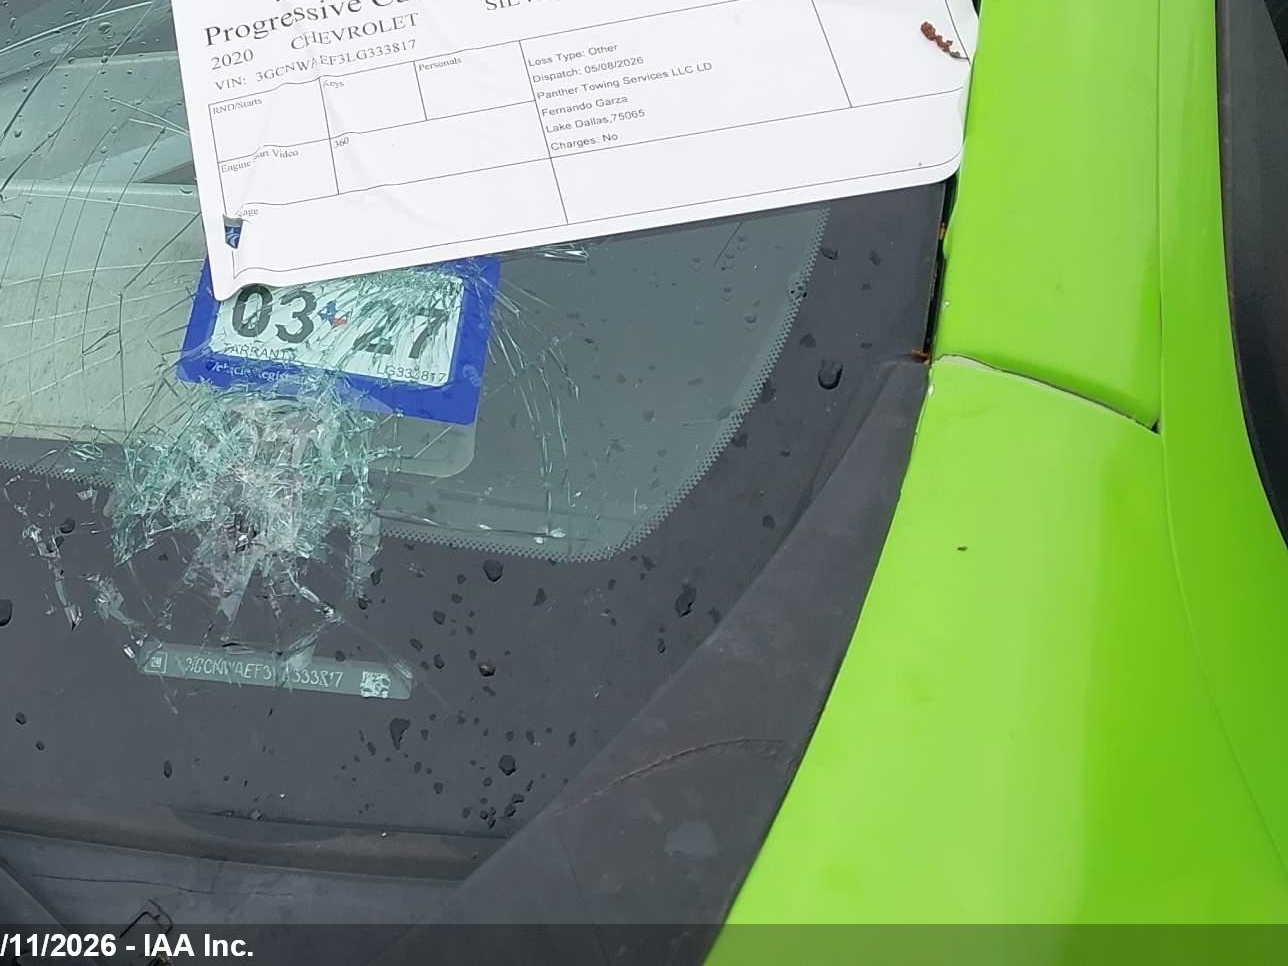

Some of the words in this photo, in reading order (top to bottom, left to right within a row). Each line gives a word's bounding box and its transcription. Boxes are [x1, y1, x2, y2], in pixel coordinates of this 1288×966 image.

[211, 49, 254, 70] 2020
[291, 12, 418, 50] CHEVROLET
[528, 56, 553, 67] Loss
[555, 50, 585, 63] Type:
[588, 44, 618, 56] Other
[532, 67, 581, 83] Dispatch:
[584, 56, 644, 74] 05/08/2026
[537, 86, 578, 100] Panther
[582, 79, 620, 92] Towing
[622, 70, 669, 85] Services
[671, 65, 694, 77] LLC
[696, 62, 712, 72] LD
[212, 98, 262, 115] RND/Starts
[418, 57, 463, 71] Personals
[215, 76, 247, 91] VIN:
[541, 101, 592, 117] Fernando
[595, 96, 628, 107] Garza
[545, 121, 572, 133] Lake
[574, 109, 646, 129] Dallas,75065
[334, 137, 349, 148] 360
[550, 135, 600, 151] Charges:
[602, 133, 618, 142] No
[221, 160, 251, 174] Engine
[272, 148, 299, 158] Video
[231, 285, 317, 344] 03
[353, 298, 450, 360] 27
